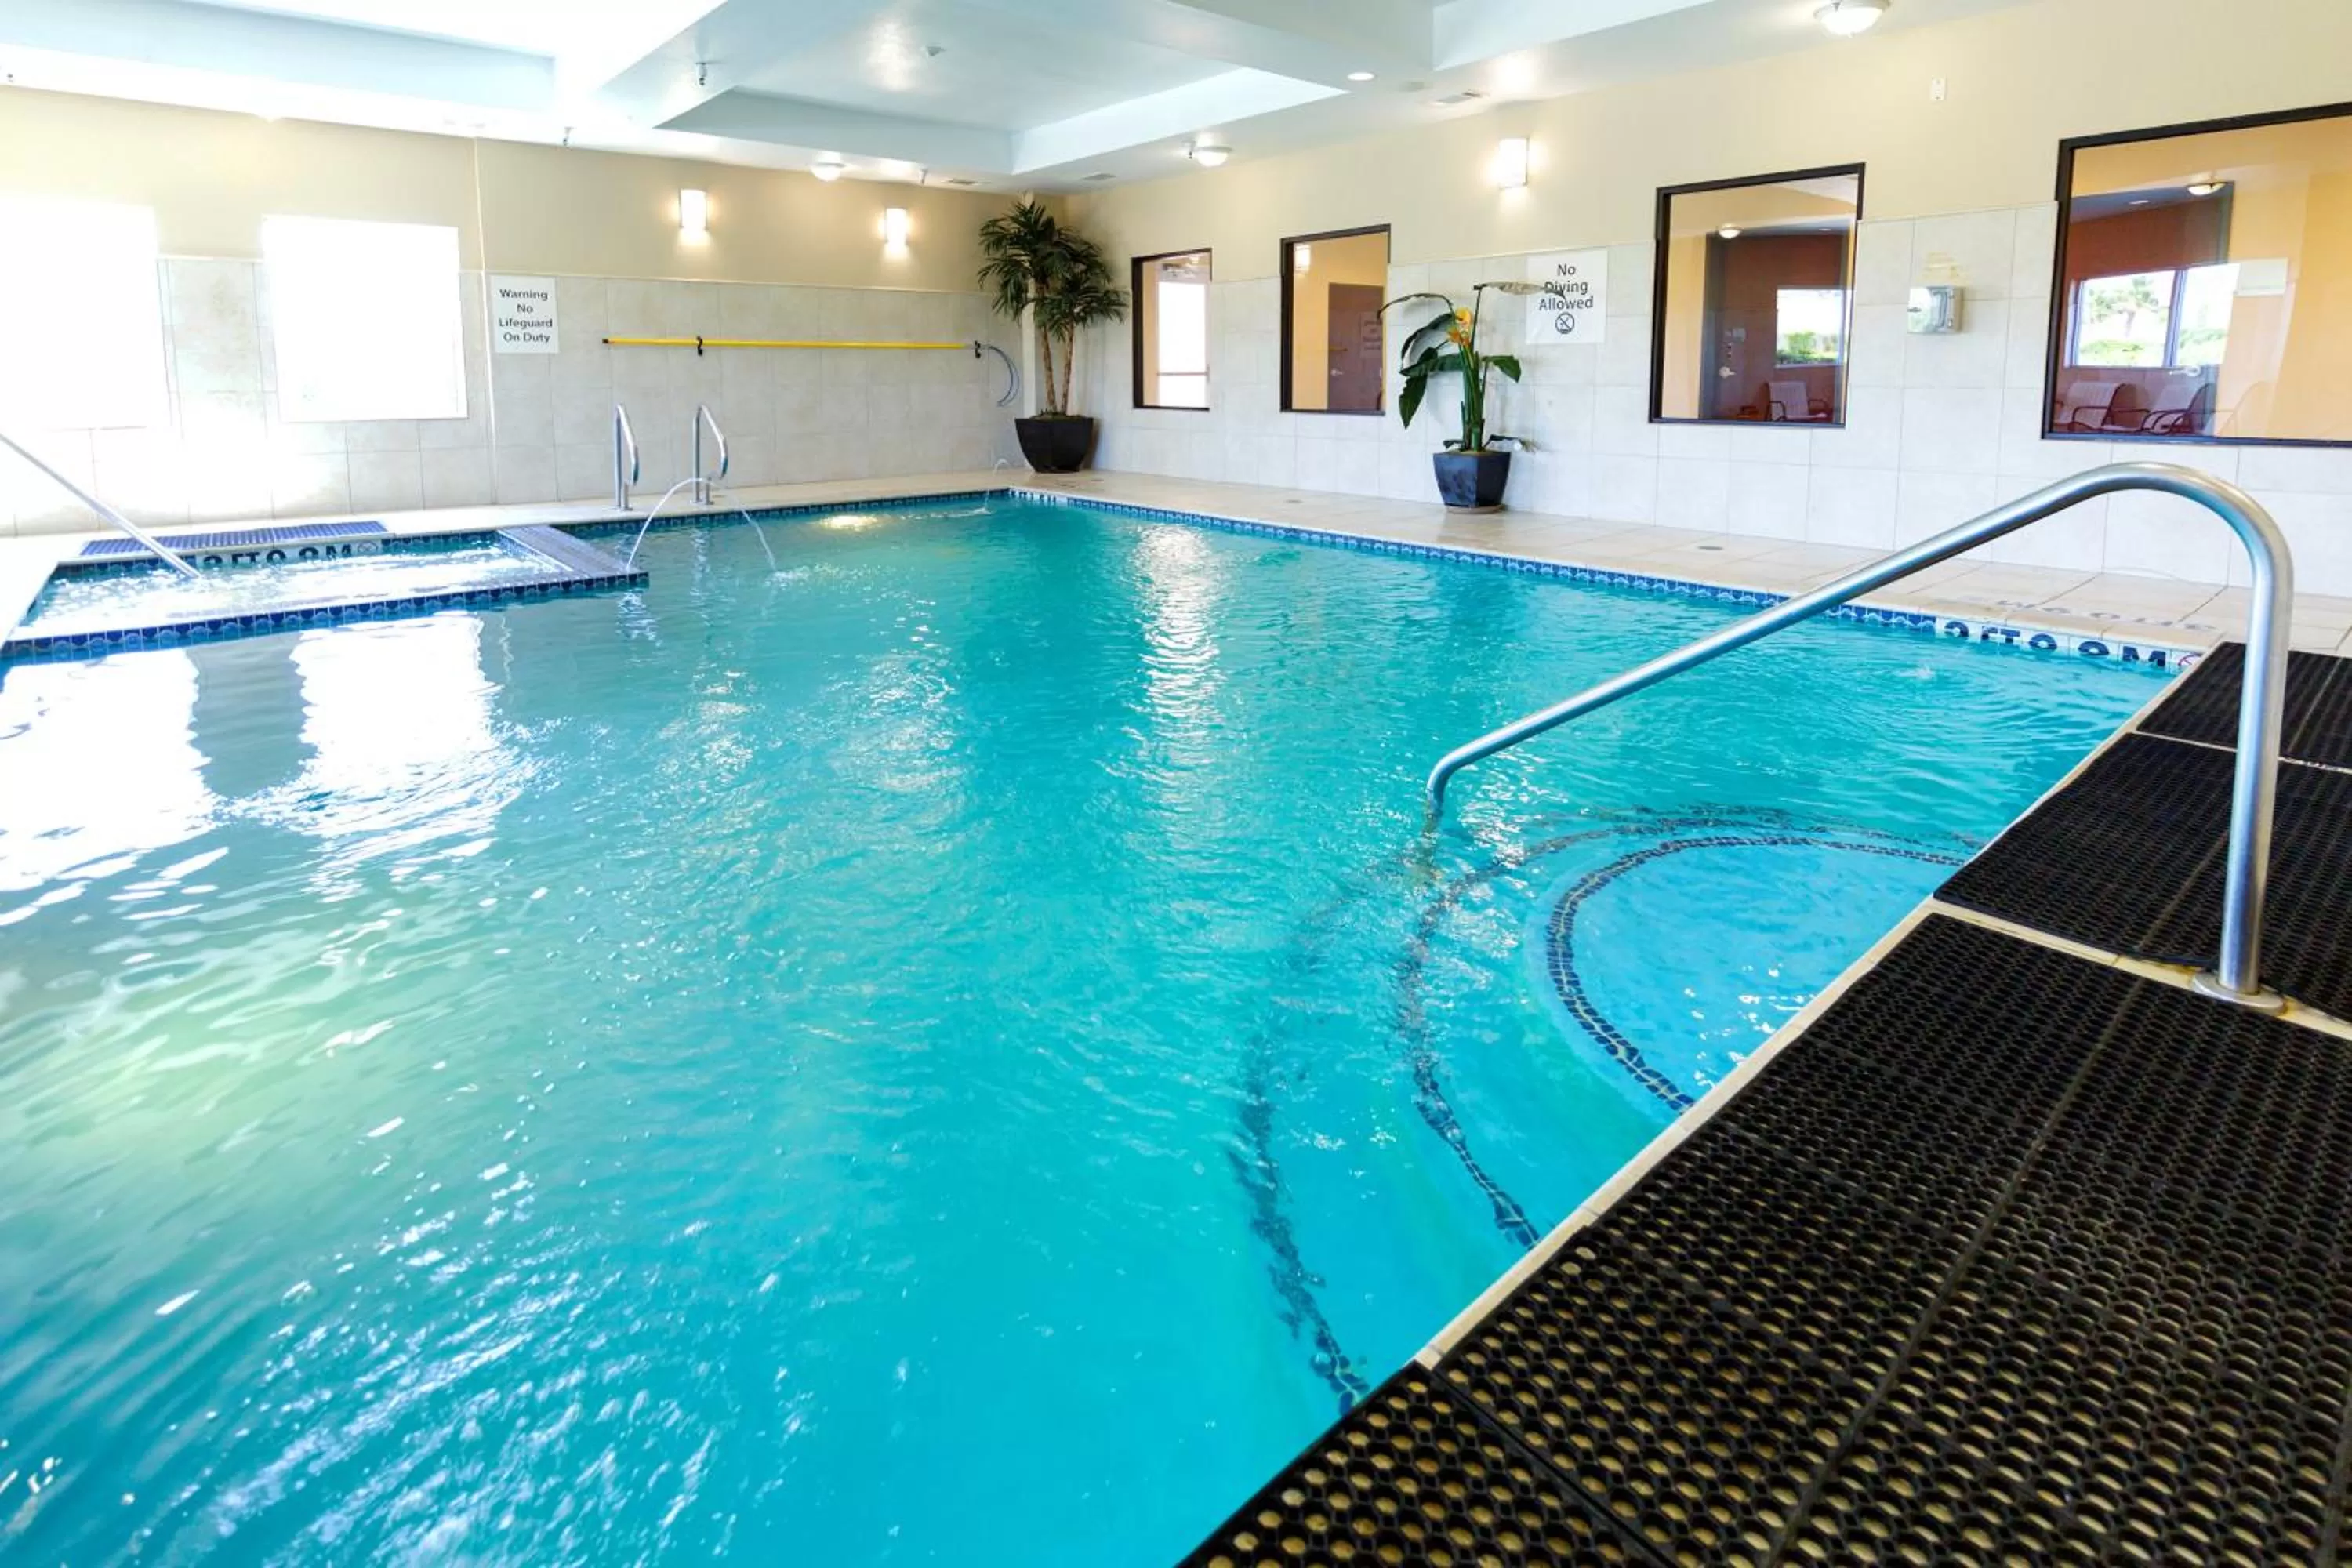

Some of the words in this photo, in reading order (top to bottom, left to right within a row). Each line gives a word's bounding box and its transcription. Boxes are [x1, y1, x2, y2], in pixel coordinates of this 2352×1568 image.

[1557, 263, 1577, 276] No
[499, 289, 549, 302] Warning
[517, 303, 534, 314] No
[1539, 295, 1594, 311] Allowed
[499, 317, 553, 330] Lifeguard
[503, 332, 521, 343] On
[523, 332, 551, 344] Duty
